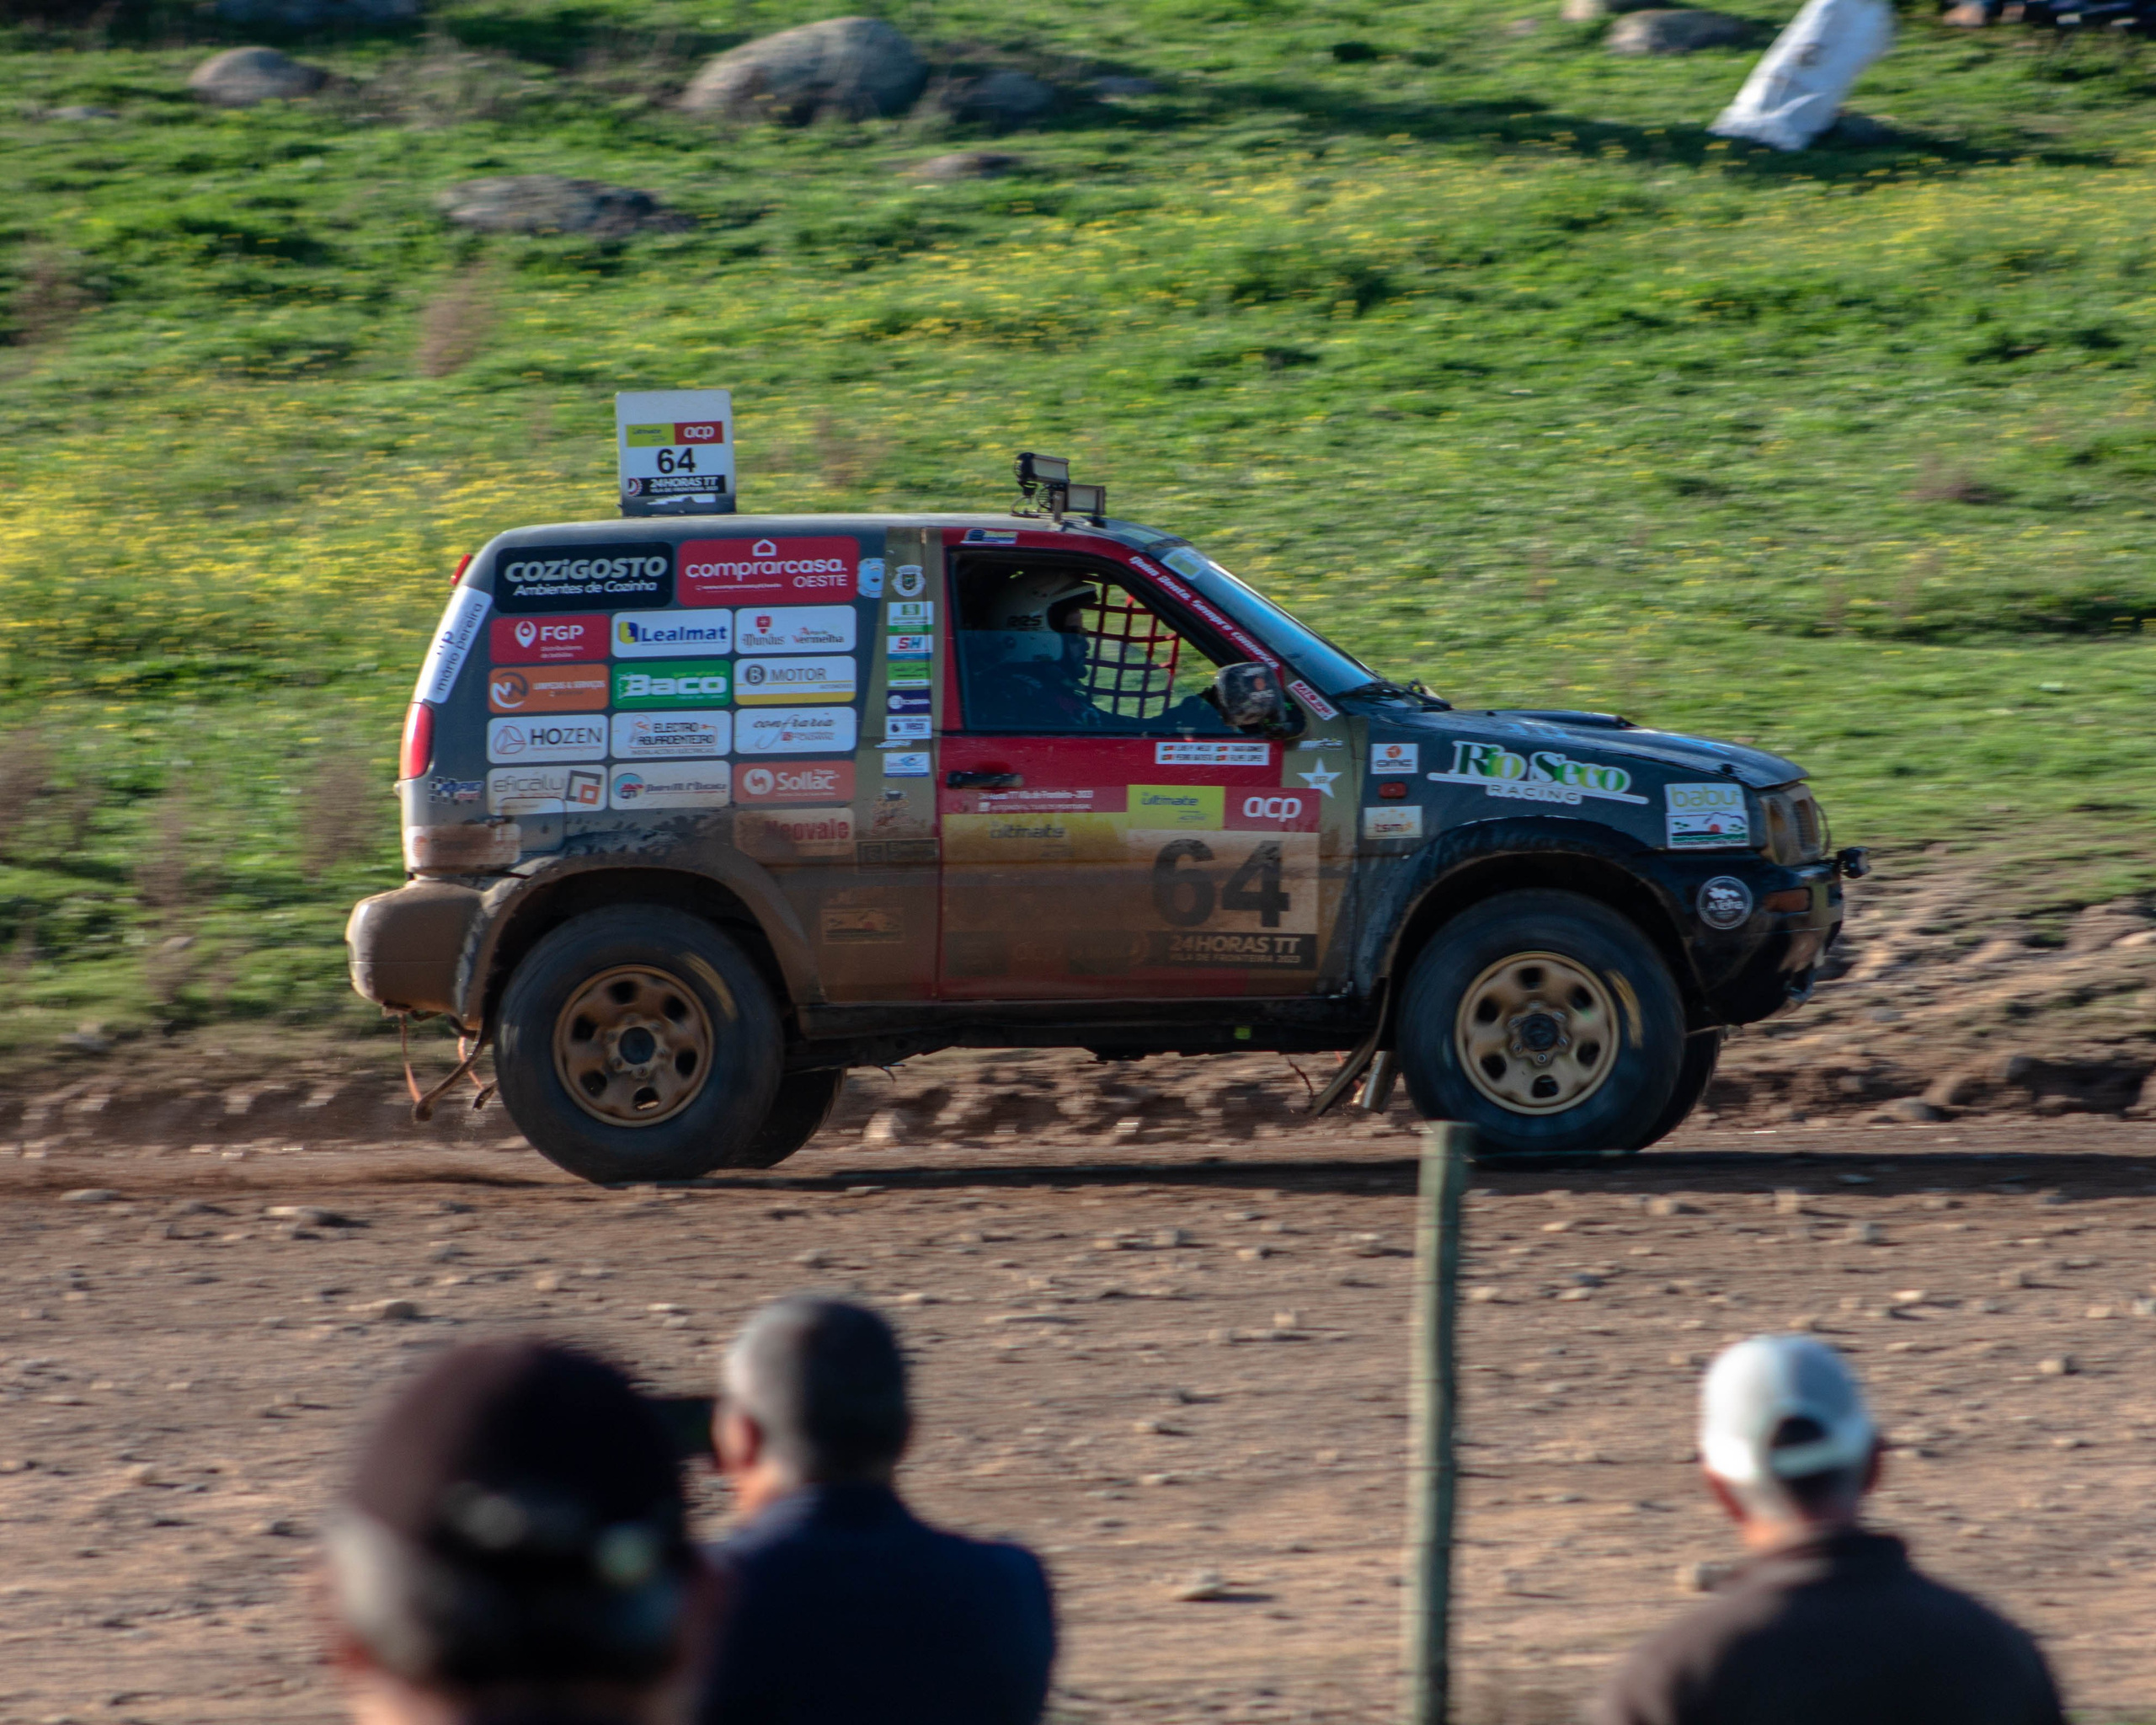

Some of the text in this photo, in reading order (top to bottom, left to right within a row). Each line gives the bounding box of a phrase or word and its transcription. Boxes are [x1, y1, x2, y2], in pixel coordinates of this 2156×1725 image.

[684, 425, 715, 440] acp
[657, 447, 696, 474] 64
[513, 579, 658, 596] Ambientes de Cozinha
[792, 574, 848, 588] OESTE
[455, 603, 483, 651] pereira
[540, 625, 584, 641] FGP
[641, 626, 728, 643] Lealmat
[792, 633, 845, 644] Vermelha
[897, 637, 923, 649] SH
[770, 668, 827, 681] MOTOR
[530, 727, 603, 745] HOZEN
[654, 722, 699, 734] ELECTRO
[1452, 741, 1631, 793] Rio Seco
[776, 771, 835, 791] Sollac
[1490, 784, 1580, 803] RACING
[1242, 795, 1303, 823] acp
[1153, 838, 1290, 927] 64
[1273, 937, 1301, 953] TT
